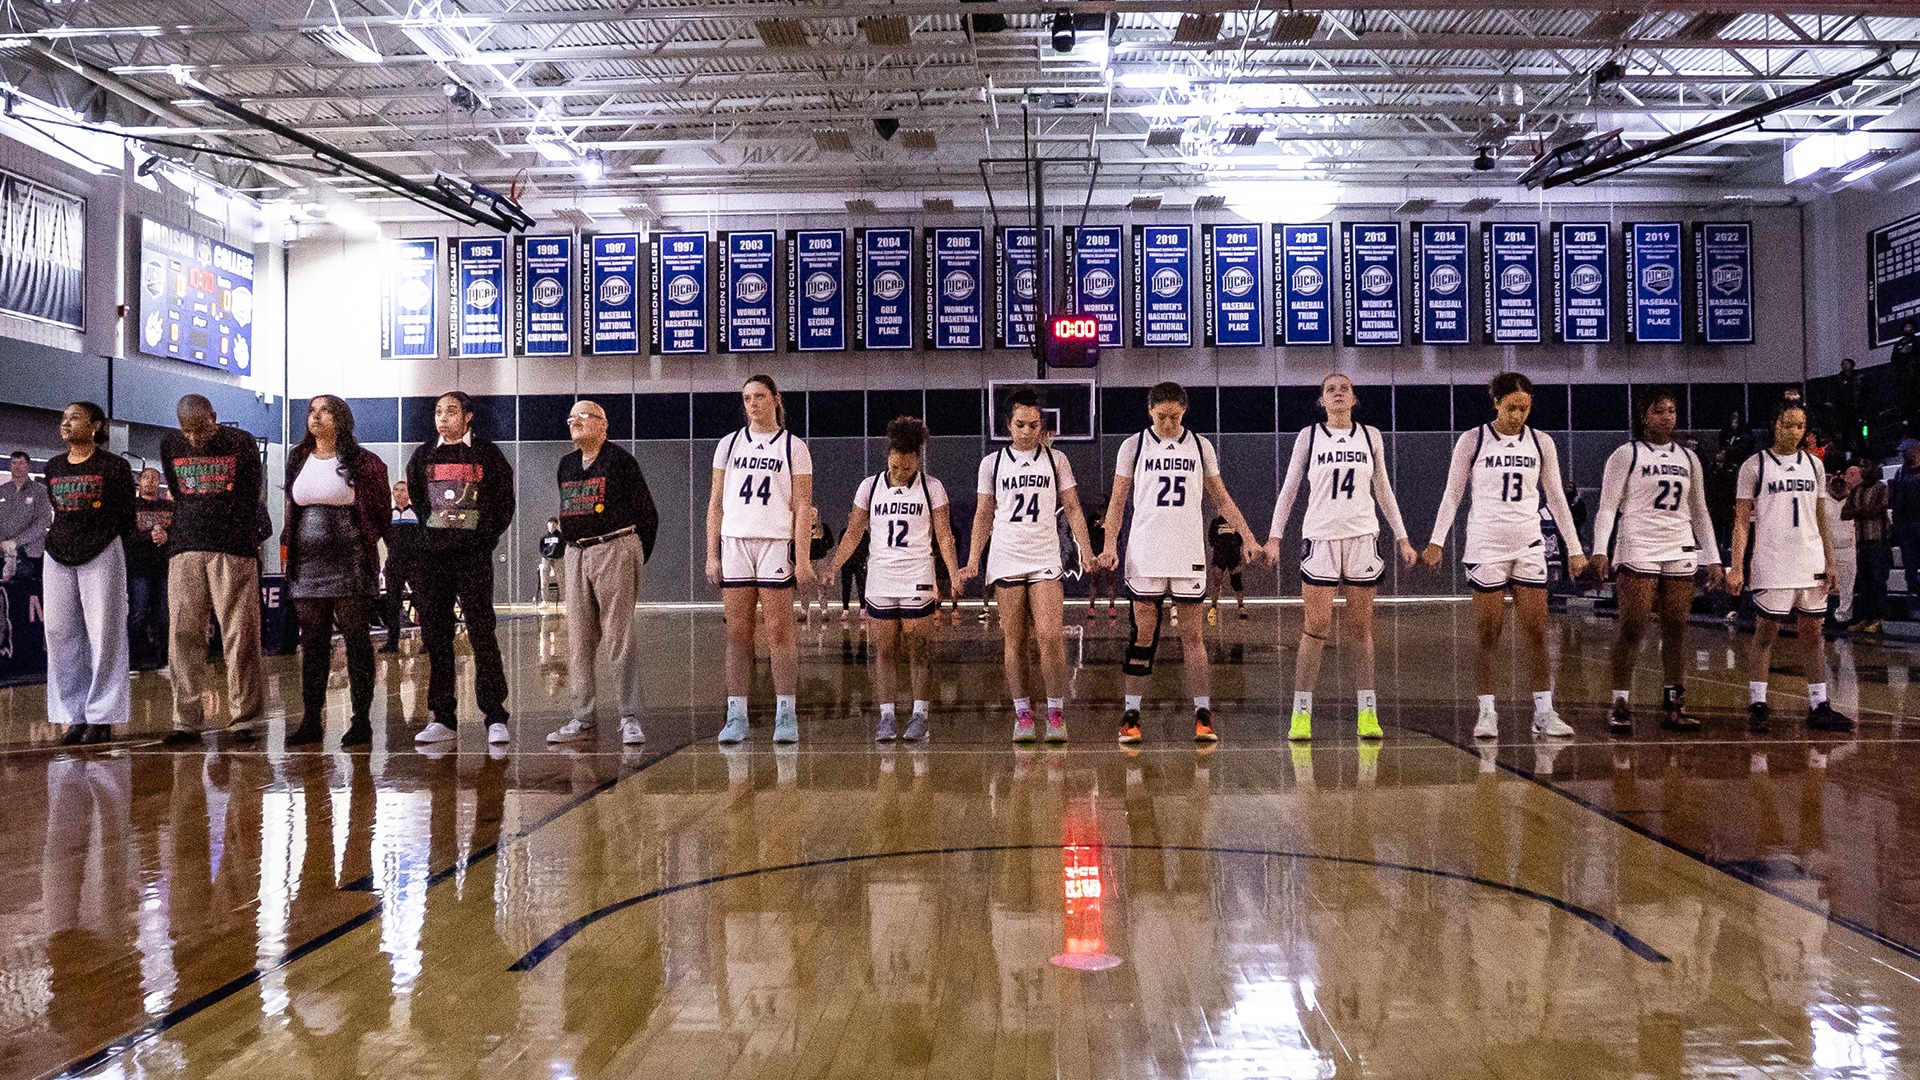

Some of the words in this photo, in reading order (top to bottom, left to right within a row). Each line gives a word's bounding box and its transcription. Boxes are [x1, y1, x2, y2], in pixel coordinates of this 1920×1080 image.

[1086, 235, 1109, 245] 2009
[1156, 235, 1178, 245] 2010
[1227, 234, 1247, 244] 2011
[1296, 233, 1317, 243] 2013
[1365, 232, 1386, 242] 2013
[1434, 232, 1456, 242] 2014
[1505, 232, 1526, 242] 2014
[1574, 232, 1596, 241] 2015
[1645, 233, 1669, 241] 2019
[1714, 233, 1739, 241] 2022
[673, 242, 694, 251] 1997
[740, 240, 762, 250] 2003
[809, 239, 832, 249] 2003
[877, 237, 900, 247] 2004
[947, 237, 970, 247] 2006
[471, 247, 493, 256] 1995
[537, 245, 558, 255] 1996
[605, 243, 626, 253] 1997
[1431, 274, 1461, 289] NJCAA
[1501, 274, 1531, 289] NJCAA
[1571, 273, 1602, 289] NJCAA
[1644, 269, 1672, 284] NJCAA
[1713, 269, 1741, 284] NJCAA
[874, 278, 904, 293] NJCAA
[944, 278, 974, 294] NJCAA
[1084, 277, 1114, 293] NJCAA
[1152, 276, 1183, 292] NJCAA
[1223, 277, 1253, 292] NJCAA
[1293, 276, 1323, 291] NJCAA
[1362, 274, 1392, 290] NJCAA
[534, 285, 563, 299] NJCAA
[602, 284, 631, 299] NJCAA
[669, 283, 699, 298] NJCAA
[737, 281, 767, 295] NJCAA
[806, 280, 836, 295] NJCAA
[1152, 303, 1182, 311] WOMEN'S
[1222, 302, 1254, 310] BASEBALL
[1291, 301, 1324, 309] BASEBALL
[1362, 300, 1392, 308] WOMEN'S
[1429, 300, 1462, 308] BASEBALL
[599, 311, 631, 319] BASEBALL
[737, 308, 766, 316] WOMEN'S
[813, 307, 829, 315] GOLF
[881, 306, 897, 314] GOLF
[944, 306, 973, 314] WOMEN'S
[875, 316, 902, 324] SECOND
[940, 315, 978, 323] BASKETBALL
[1298, 312, 1318, 320] THIRD
[600, 321, 631, 329] NATIONAL
[733, 318, 770, 326] BASKETBALL
[808, 318, 834, 326] SECOND
[1151, 323, 1183, 331] NATIONAL
[1229, 323, 1249, 331] PLACE
[1298, 322, 1318, 330] PLACE
[1362, 321, 1393, 329] NATIONAL
[1436, 321, 1456, 329] PLACE
[738, 328, 765, 336] SECOND
[811, 328, 831, 336] PLACE
[1056, 320, 1095, 337] 10:00
[1576, 328, 1597, 336] PLACE
[596, 331, 635, 340] CHAMPIONS
[674, 330, 693, 338] THIRD
[1147, 333, 1187, 341] CHAMPIONS
[1358, 331, 1398, 339] CHAMPIONS
[1497, 330, 1537, 338] CHAMPIONS
[674, 340, 694, 348] PLACE
[742, 338, 762, 346] PLACE
[949, 336, 969, 344] PLACE
[1318, 451, 1367, 466] MADISON
[1485, 456, 1536, 469] MADISON
[734, 457, 782, 472] MADISON
[1145, 458, 1196, 472] MADISON
[1642, 464, 1690, 478] MADISON
[1002, 475, 1050, 492] MADISON
[1331, 469, 1355, 499] 14
[1502, 473, 1523, 502] 13
[1768, 480, 1814, 494] MADISON
[740, 474, 771, 505] 44
[1157, 477, 1186, 506] 25
[1654, 481, 1682, 510] 23
[874, 502, 923, 516] MADISON
[1010, 493, 1039, 522] 24
[1792, 498, 1798, 527] 1
[888, 520, 909, 547] 12
